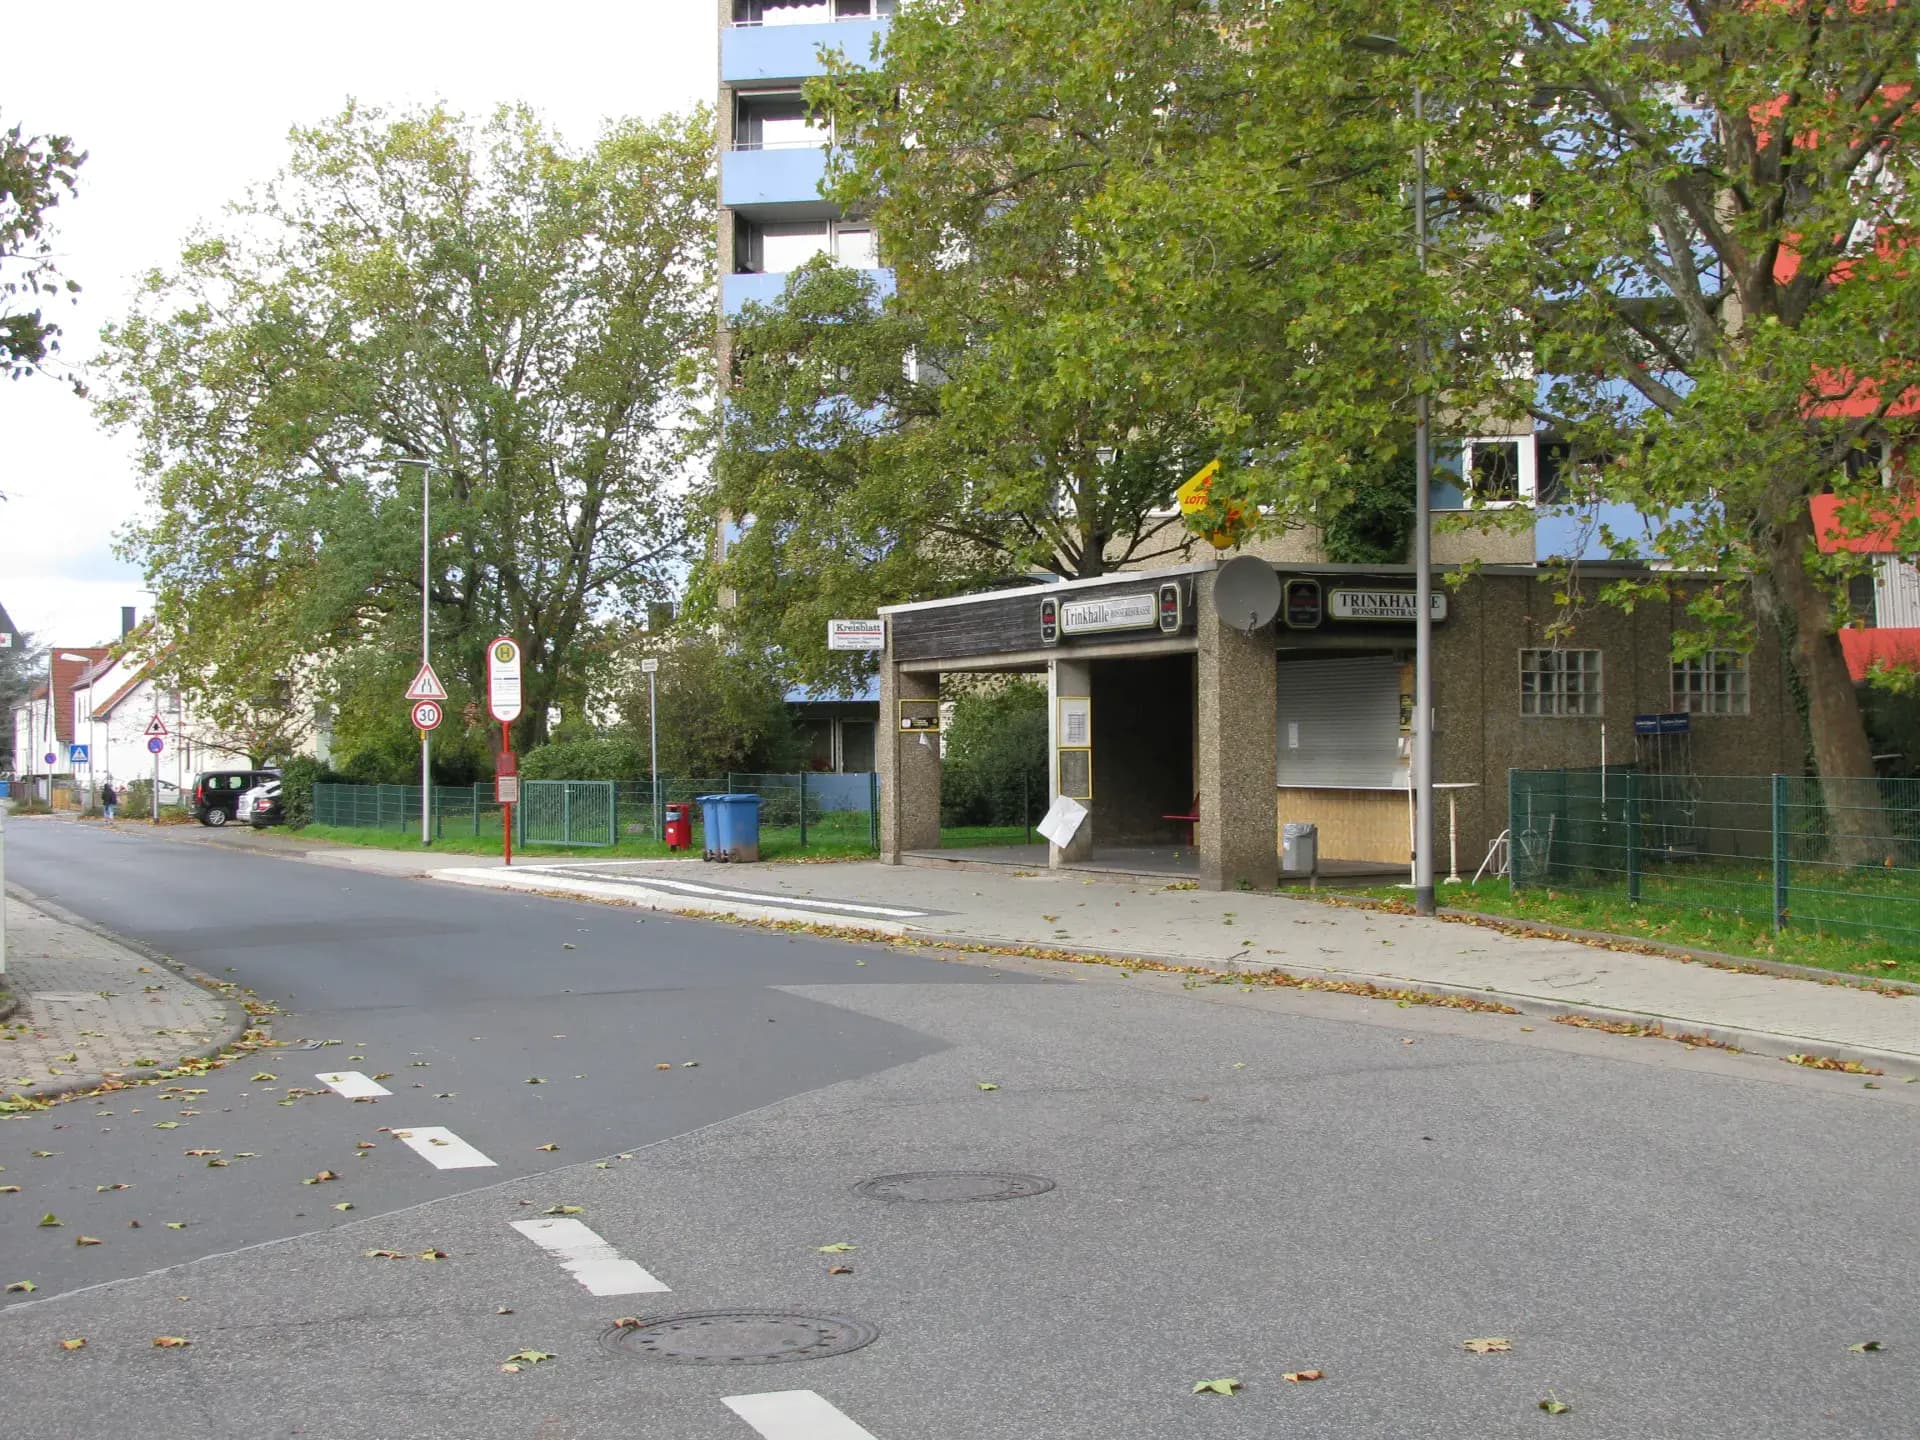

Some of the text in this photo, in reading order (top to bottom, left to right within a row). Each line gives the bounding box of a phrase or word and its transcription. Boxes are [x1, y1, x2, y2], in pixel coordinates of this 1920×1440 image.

[1184, 496, 1209, 505] LOTT
[1340, 594, 1440, 608] TRINKHAE
[1064, 604, 1110, 626] Trinkhalle
[836, 623, 881, 631] Kreisblatt
[500, 647, 510, 658] H
[419, 709, 435, 721] 30
